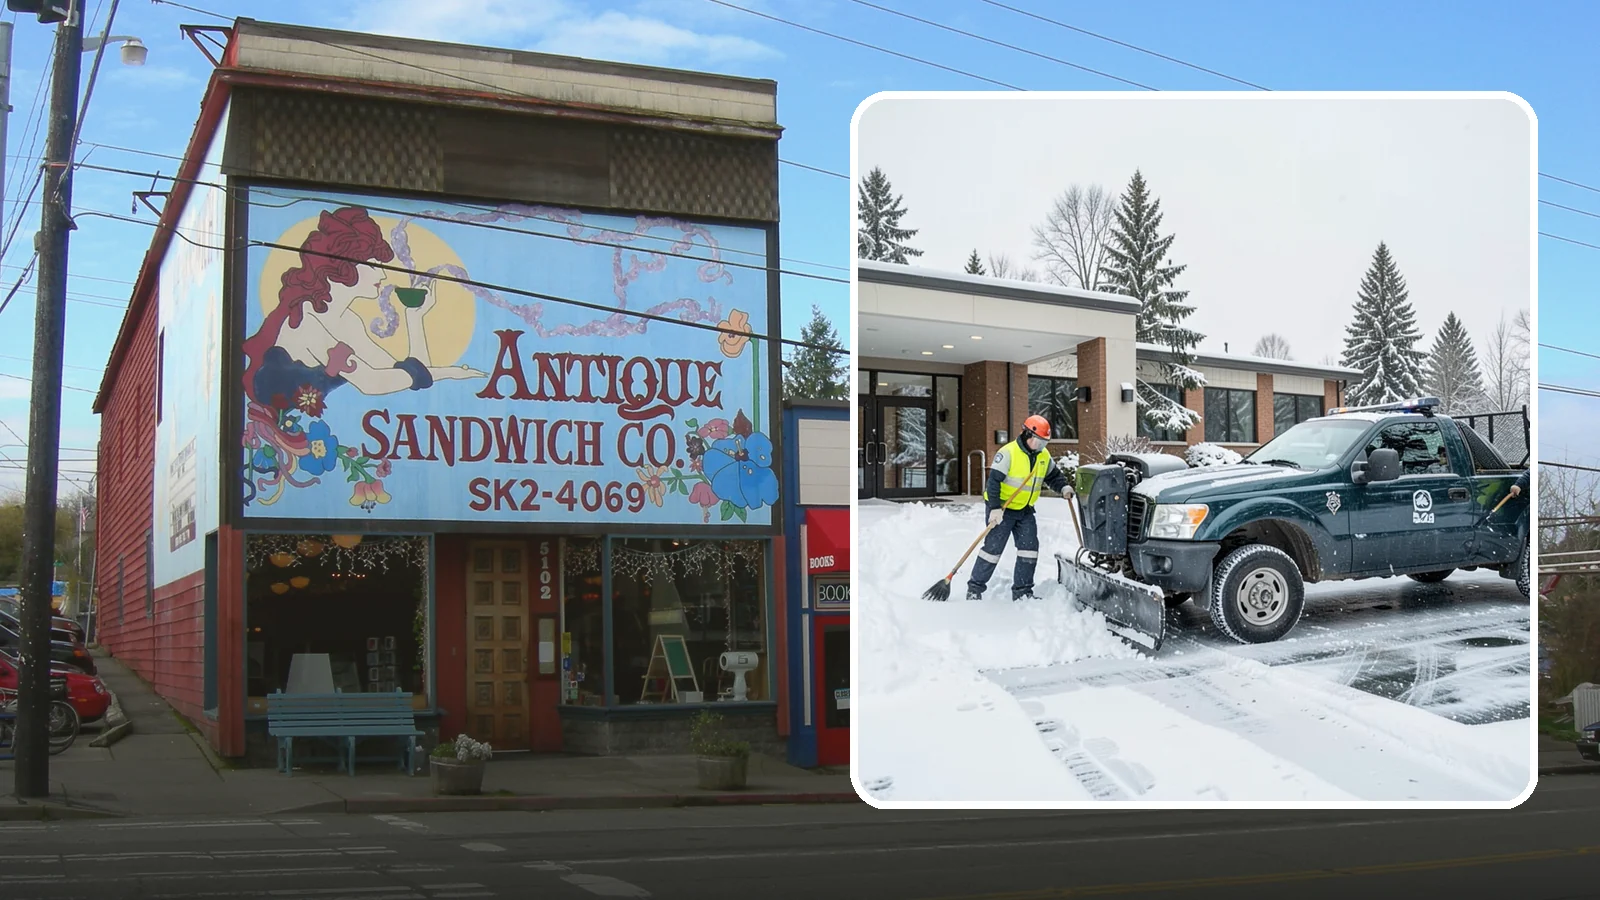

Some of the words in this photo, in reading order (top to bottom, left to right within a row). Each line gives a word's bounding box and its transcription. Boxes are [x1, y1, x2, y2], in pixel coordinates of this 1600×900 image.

[476, 329, 724, 421] ANTIQUE
[361, 409, 605, 467] SANDWICH
[616, 421, 687, 469] CO.
[469, 476, 646, 513] SK2-4069
[540, 541, 551, 599] 5102
[809, 555, 835, 569] BOOKS
